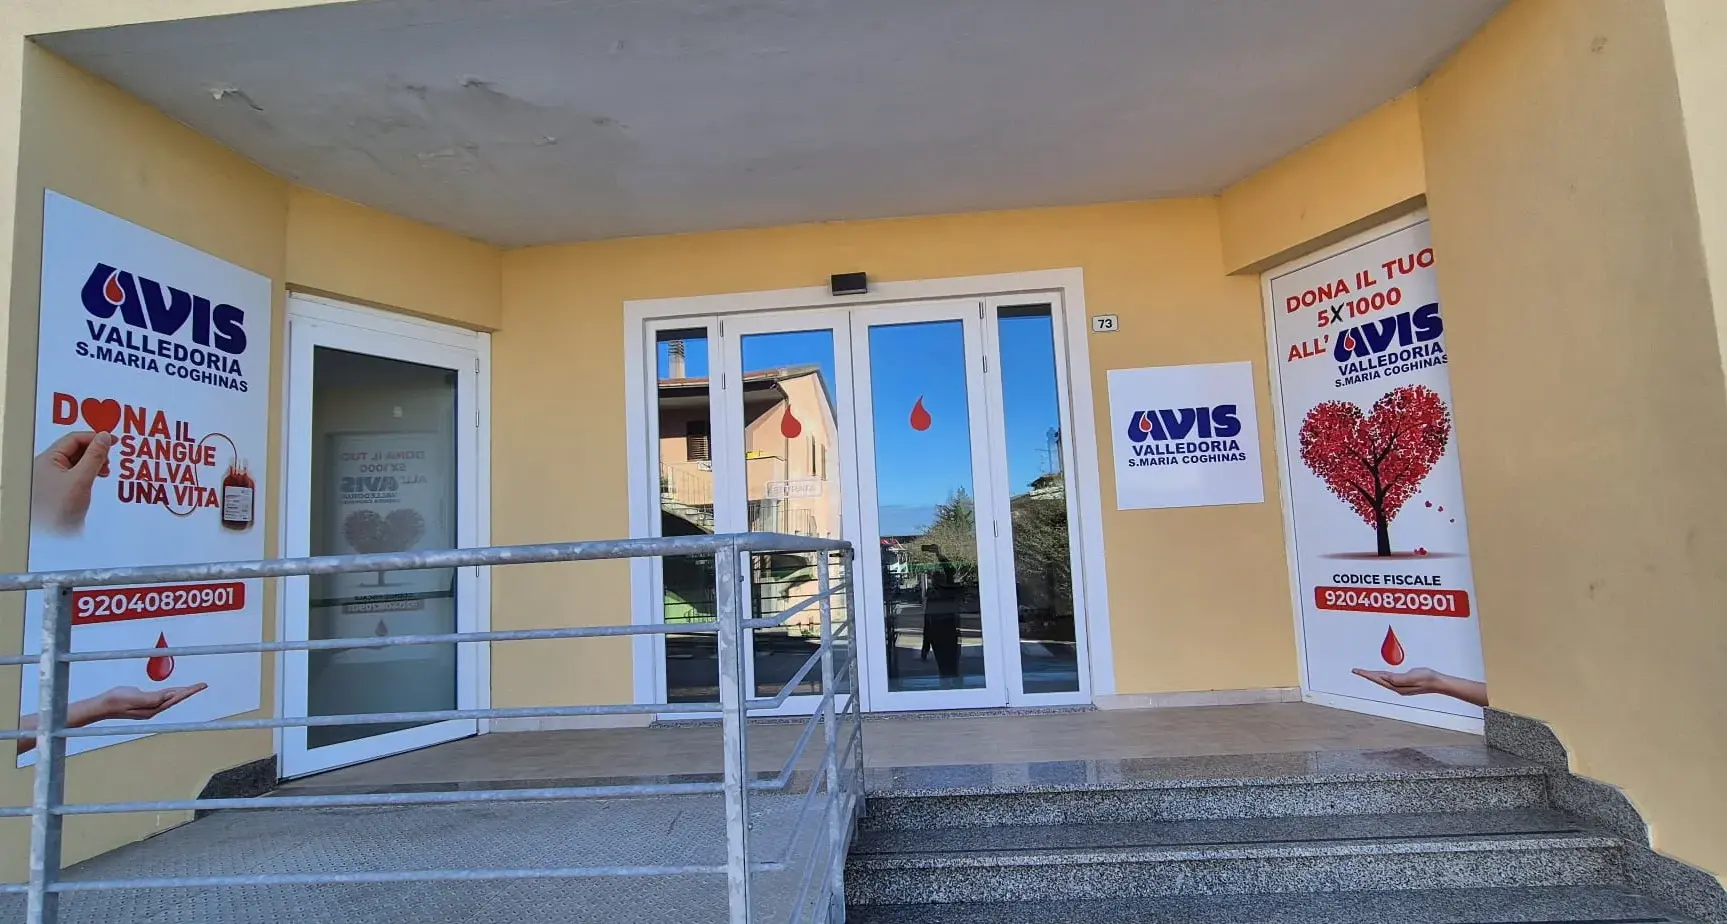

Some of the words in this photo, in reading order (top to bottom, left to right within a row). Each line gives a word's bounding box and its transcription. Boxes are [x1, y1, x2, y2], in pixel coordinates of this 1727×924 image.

[1286, 278, 1350, 314] DONA
[1355, 270, 1378, 290] IL
[1381, 248, 1435, 280] TUO
[81, 263, 247, 354] AVIS
[1098, 319, 1113, 329] 73
[1287, 335, 1330, 362] ALL'
[1333, 302, 1444, 363] AVIS
[86, 319, 242, 377] VALLEDORIA
[1338, 341, 1444, 377] VALLEDORIA
[75, 341, 159, 373] S.MARIA
[164, 363, 248, 393] COGHINAS
[1335, 369, 1381, 388] S.MARIA
[1384, 354, 1448, 377] COGHINAS
[175, 420, 196, 443] IL
[1127, 404, 1242, 443] AVIS
[119, 435, 216, 466] SANGUE
[1128, 457, 1179, 467] S.MARIA
[1182, 452, 1246, 464] COGHINAS
[1132, 439, 1240, 457] VALLEDORIA
[119, 457, 196, 485] SALVA
[118, 481, 170, 506] UNA
[173, 485, 220, 508] VITA
[1332, 573, 1380, 585] CODICE
[1383, 574, 1442, 586] FISCALE
[78, 588, 234, 617] 92040820901
[1325, 590, 1456, 612] 92040820901
